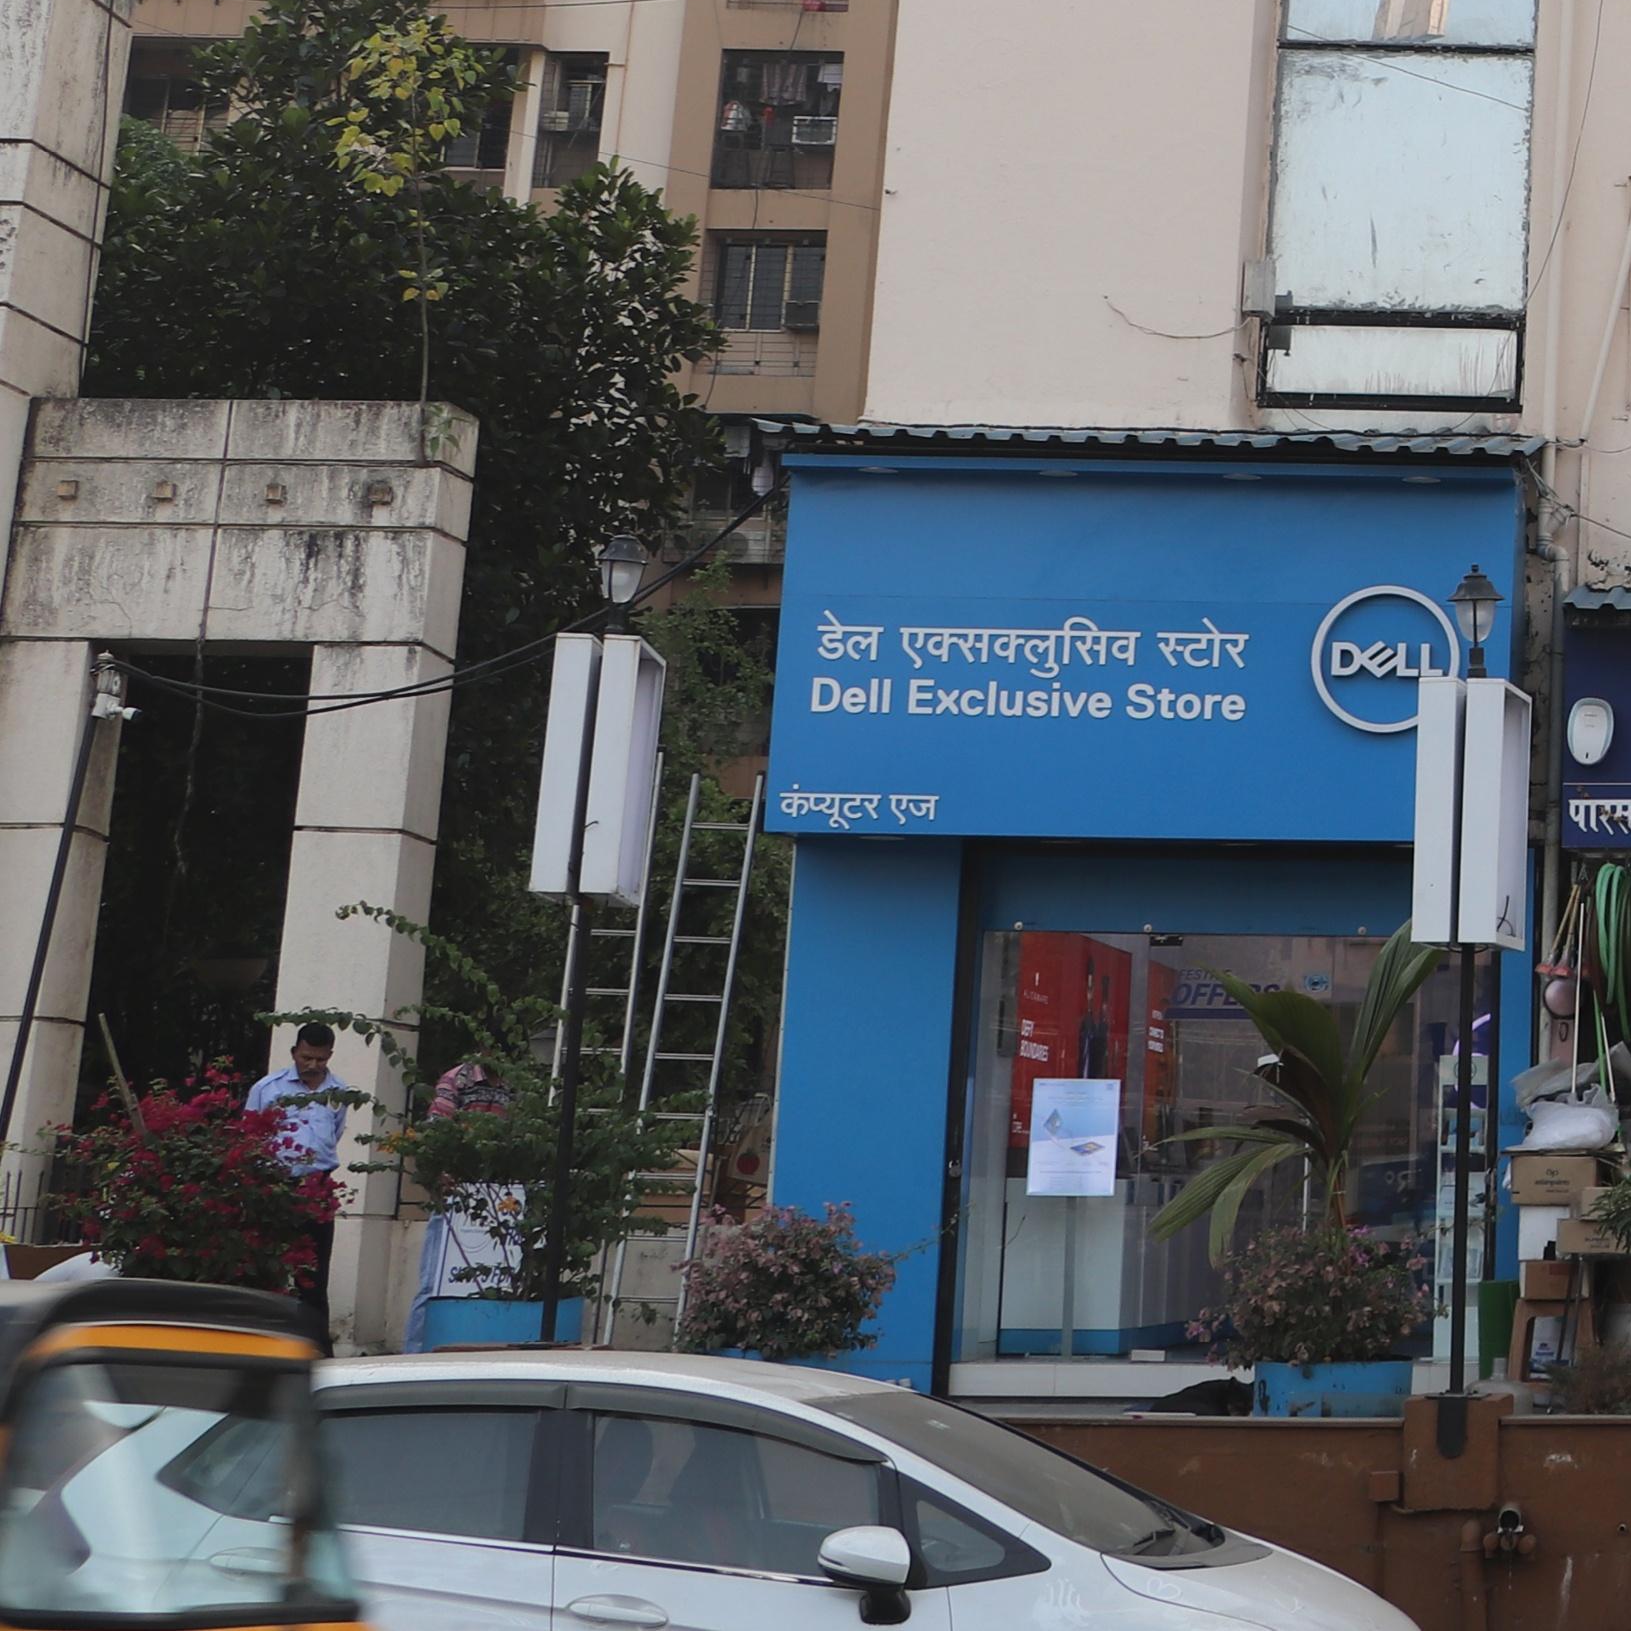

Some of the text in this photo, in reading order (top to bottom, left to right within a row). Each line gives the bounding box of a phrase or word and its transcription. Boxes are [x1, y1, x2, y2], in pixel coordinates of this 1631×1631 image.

[817, 609, 883, 661] डेल
[1157, 618, 1249, 669] स्टोर
[1330, 641, 1444, 679] DELL
[810, 677, 1247, 722] Dell Exclusive Store
[780, 784, 939, 830] कंप्यूटर एज
